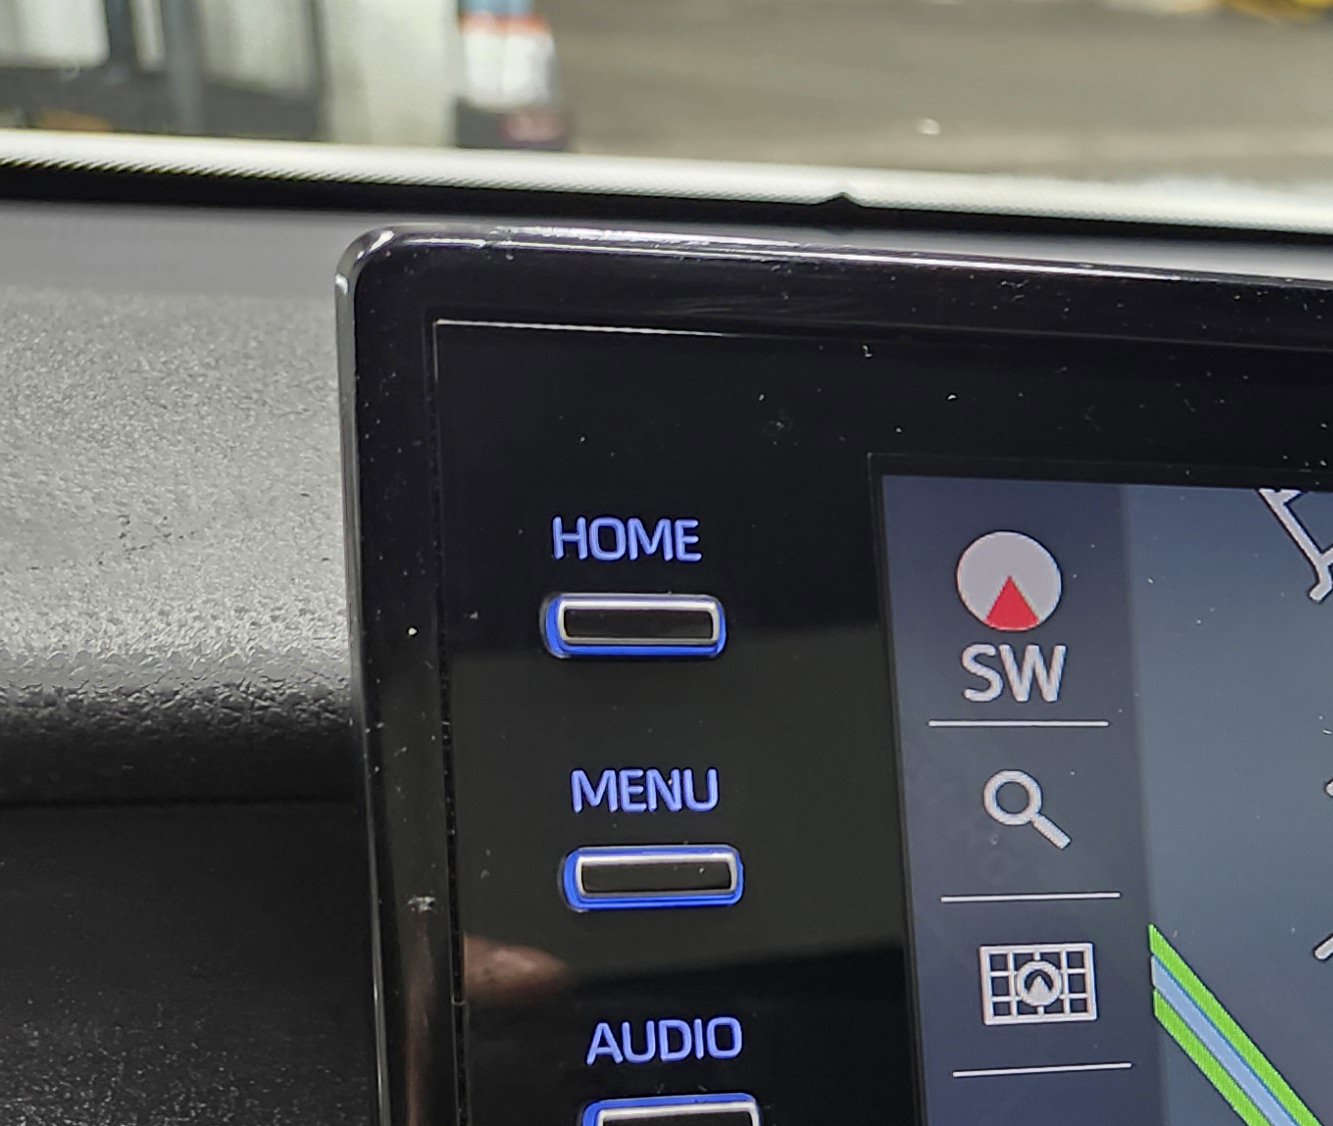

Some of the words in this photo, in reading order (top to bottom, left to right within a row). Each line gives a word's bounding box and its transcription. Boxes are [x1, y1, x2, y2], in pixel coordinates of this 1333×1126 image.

[551, 516, 703, 562] HOME
[960, 643, 1067, 704] SW
[570, 768, 720, 813] MENU
[586, 1016, 744, 1065] AUDIO
